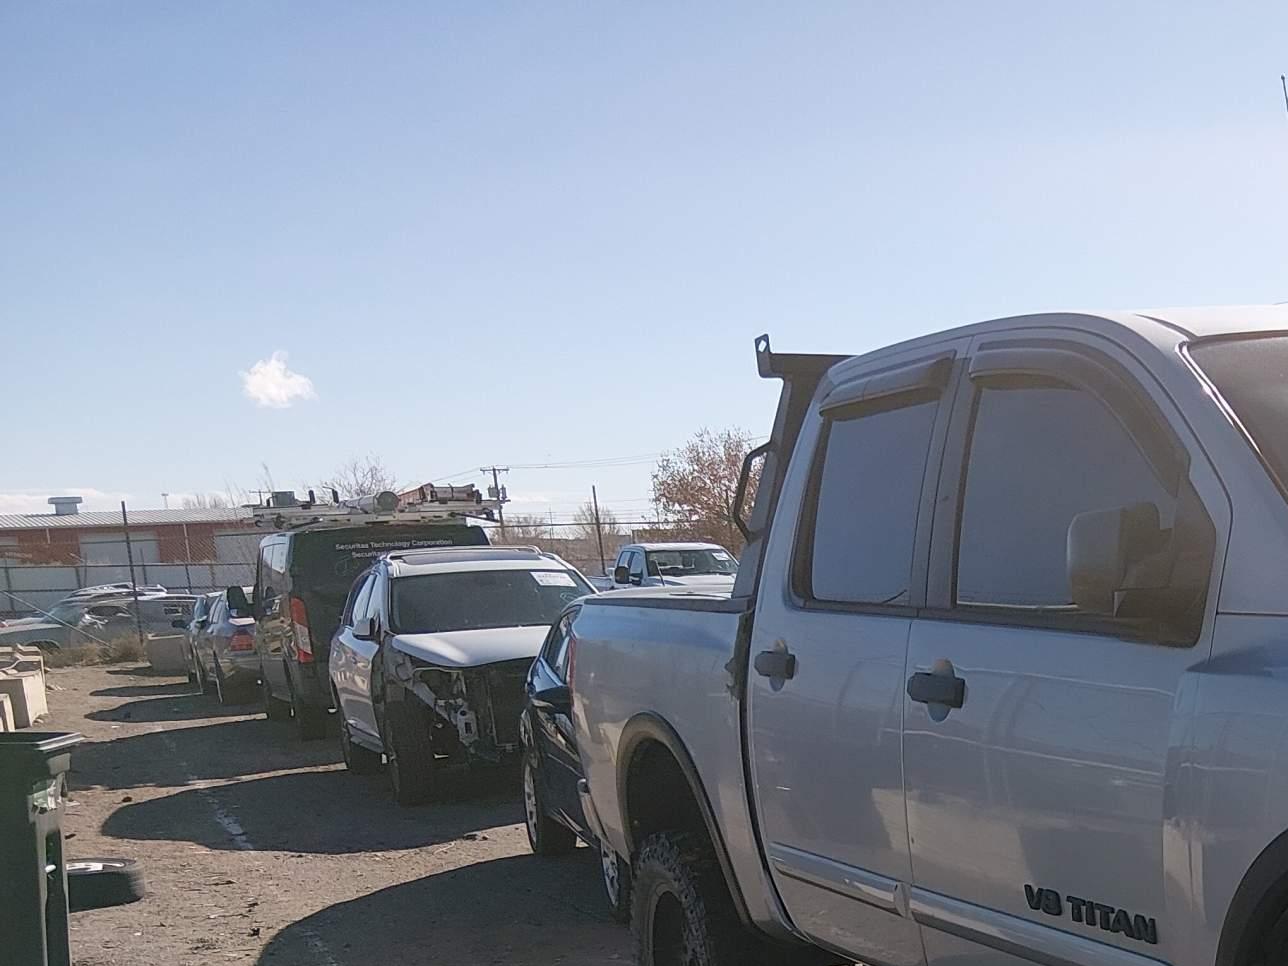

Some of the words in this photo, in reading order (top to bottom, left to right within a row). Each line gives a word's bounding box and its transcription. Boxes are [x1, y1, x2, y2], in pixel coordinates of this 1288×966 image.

[336, 542, 369, 551] Securitas
[370, 541, 411, 549] Technology
[412, 538, 453, 547] Corporation
[1024, 884, 1062, 916] V8
[1066, 895, 1158, 945] TITAN
